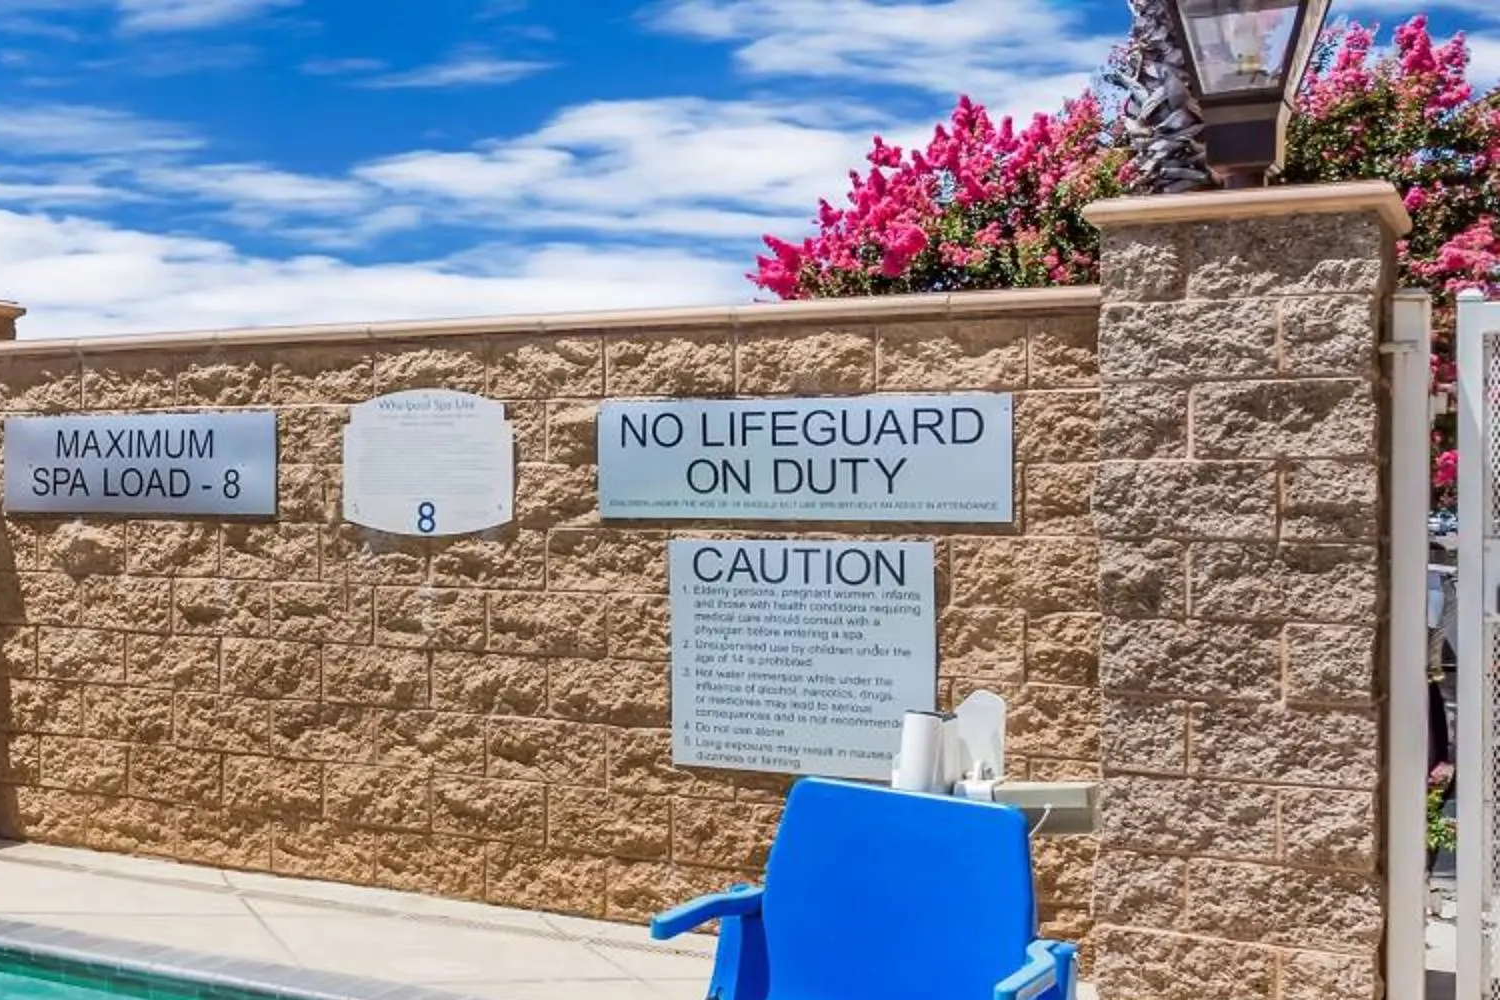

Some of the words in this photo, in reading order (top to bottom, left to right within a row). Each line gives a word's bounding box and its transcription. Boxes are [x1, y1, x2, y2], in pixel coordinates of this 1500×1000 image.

[620, 412, 684, 448] NO
[700, 407, 985, 448] LIFEGUARD
[56, 429, 214, 459] MAXIMUM
[30, 467, 90, 497] SPA
[103, 467, 190, 498] LOAD
[223, 469, 240, 499] 8
[686, 458, 751, 494] ON
[774, 457, 907, 494] DUTY
[417, 501, 436, 533] 8
[693, 547, 906, 586] CAUTION
[693, 586, 729, 598] Elderly
[782, 588, 831, 600] pregnant
[694, 600, 714, 609] and
[717, 600, 747, 609] those
[748, 600, 770, 610] with
[773, 600, 806, 610] health
[809, 602, 867, 612] conditions
[870, 604, 921, 616] requiring
[694, 612, 735, 622] medical
[737, 615, 760, 623] care
[763, 614, 800, 624] should
[803, 615, 843, 626] consult
[846, 617, 869, 627] with
[873, 619, 880, 627] a
[747, 626, 780, 637] before
[783, 628, 828, 640] entering
[832, 631, 838, 639] a
[695, 640, 767, 652] Unsupervised
[770, 644, 789, 653] use
[791, 643, 805, 655] by
[807, 644, 853, 656] children
[856, 644, 890, 657] under
[893, 647, 912, 658] the
[695, 654, 715, 664] age
[718, 653, 729, 663] of
[732, 655, 744, 664] 14
[747, 656, 755, 665] is
[695, 668, 713, 678] Hot
[716, 670, 745, 680] water
[747, 671, 803, 682] immersion
[806, 673, 835, 684] while
[839, 675, 872, 686] under
[875, 677, 893, 687] the
[695, 681, 742, 693] influence
[745, 683, 755, 694] of
[695, 695, 705, 703] or
[708, 696, 762, 706] medicines
[764, 699, 787, 709] may
[790, 700, 815, 710] lead
[817, 701, 828, 710] to
[831, 703, 872, 713] serious
[695, 708, 771, 721] consequences
[774, 713, 795, 723] and
[797, 714, 807, 723] is
[810, 715, 827, 725] not
[695, 722, 710, 733] Do
[713, 724, 730, 734] not
[733, 726, 752, 735] use
[695, 738, 722, 750] Long
[724, 740, 773, 752] exposure
[776, 744, 800, 755] may
[803, 747, 833, 757] result
[838, 749, 847, 757] in
[695, 751, 744, 763] dizziness
[747, 755, 757, 764] or
